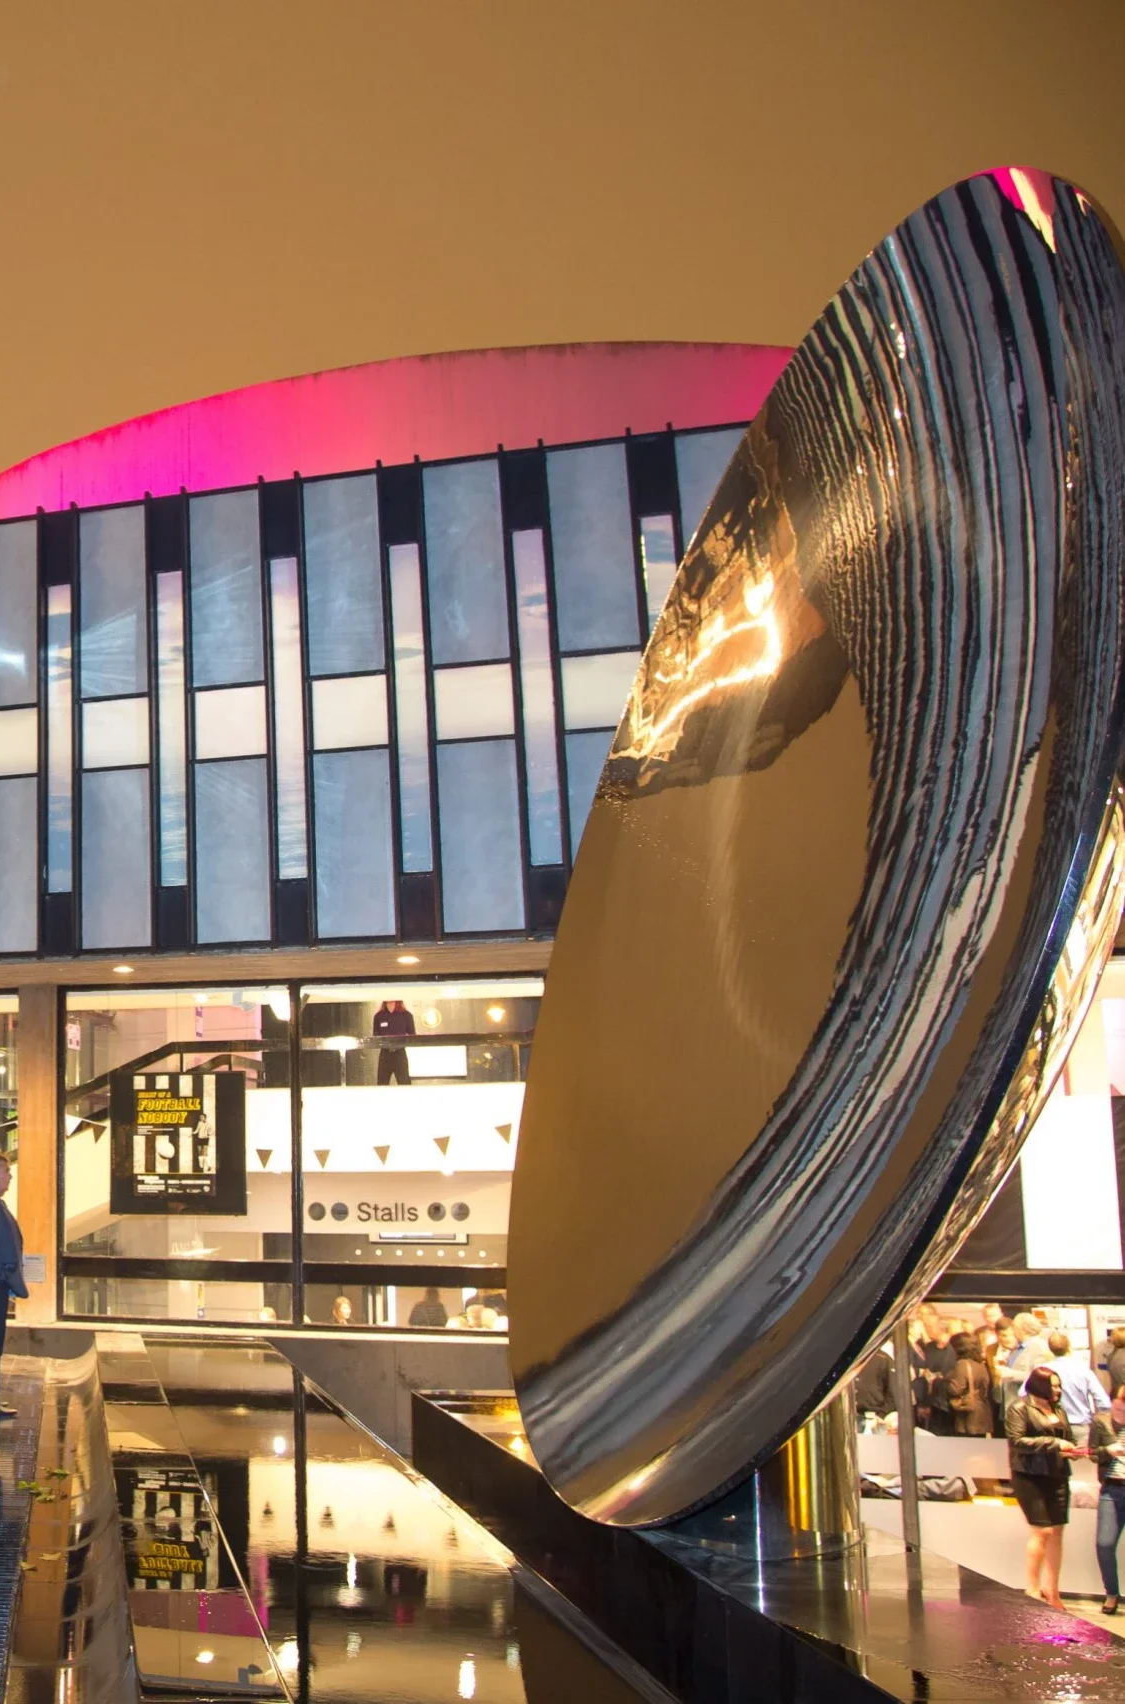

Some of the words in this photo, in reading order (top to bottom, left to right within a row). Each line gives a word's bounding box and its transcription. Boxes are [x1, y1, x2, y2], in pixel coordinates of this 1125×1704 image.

[137, 1098, 201, 1111] FOOTBALL
[137, 1111, 188, 1124] NOBODY
[357, 1202, 419, 1222] Stalls
